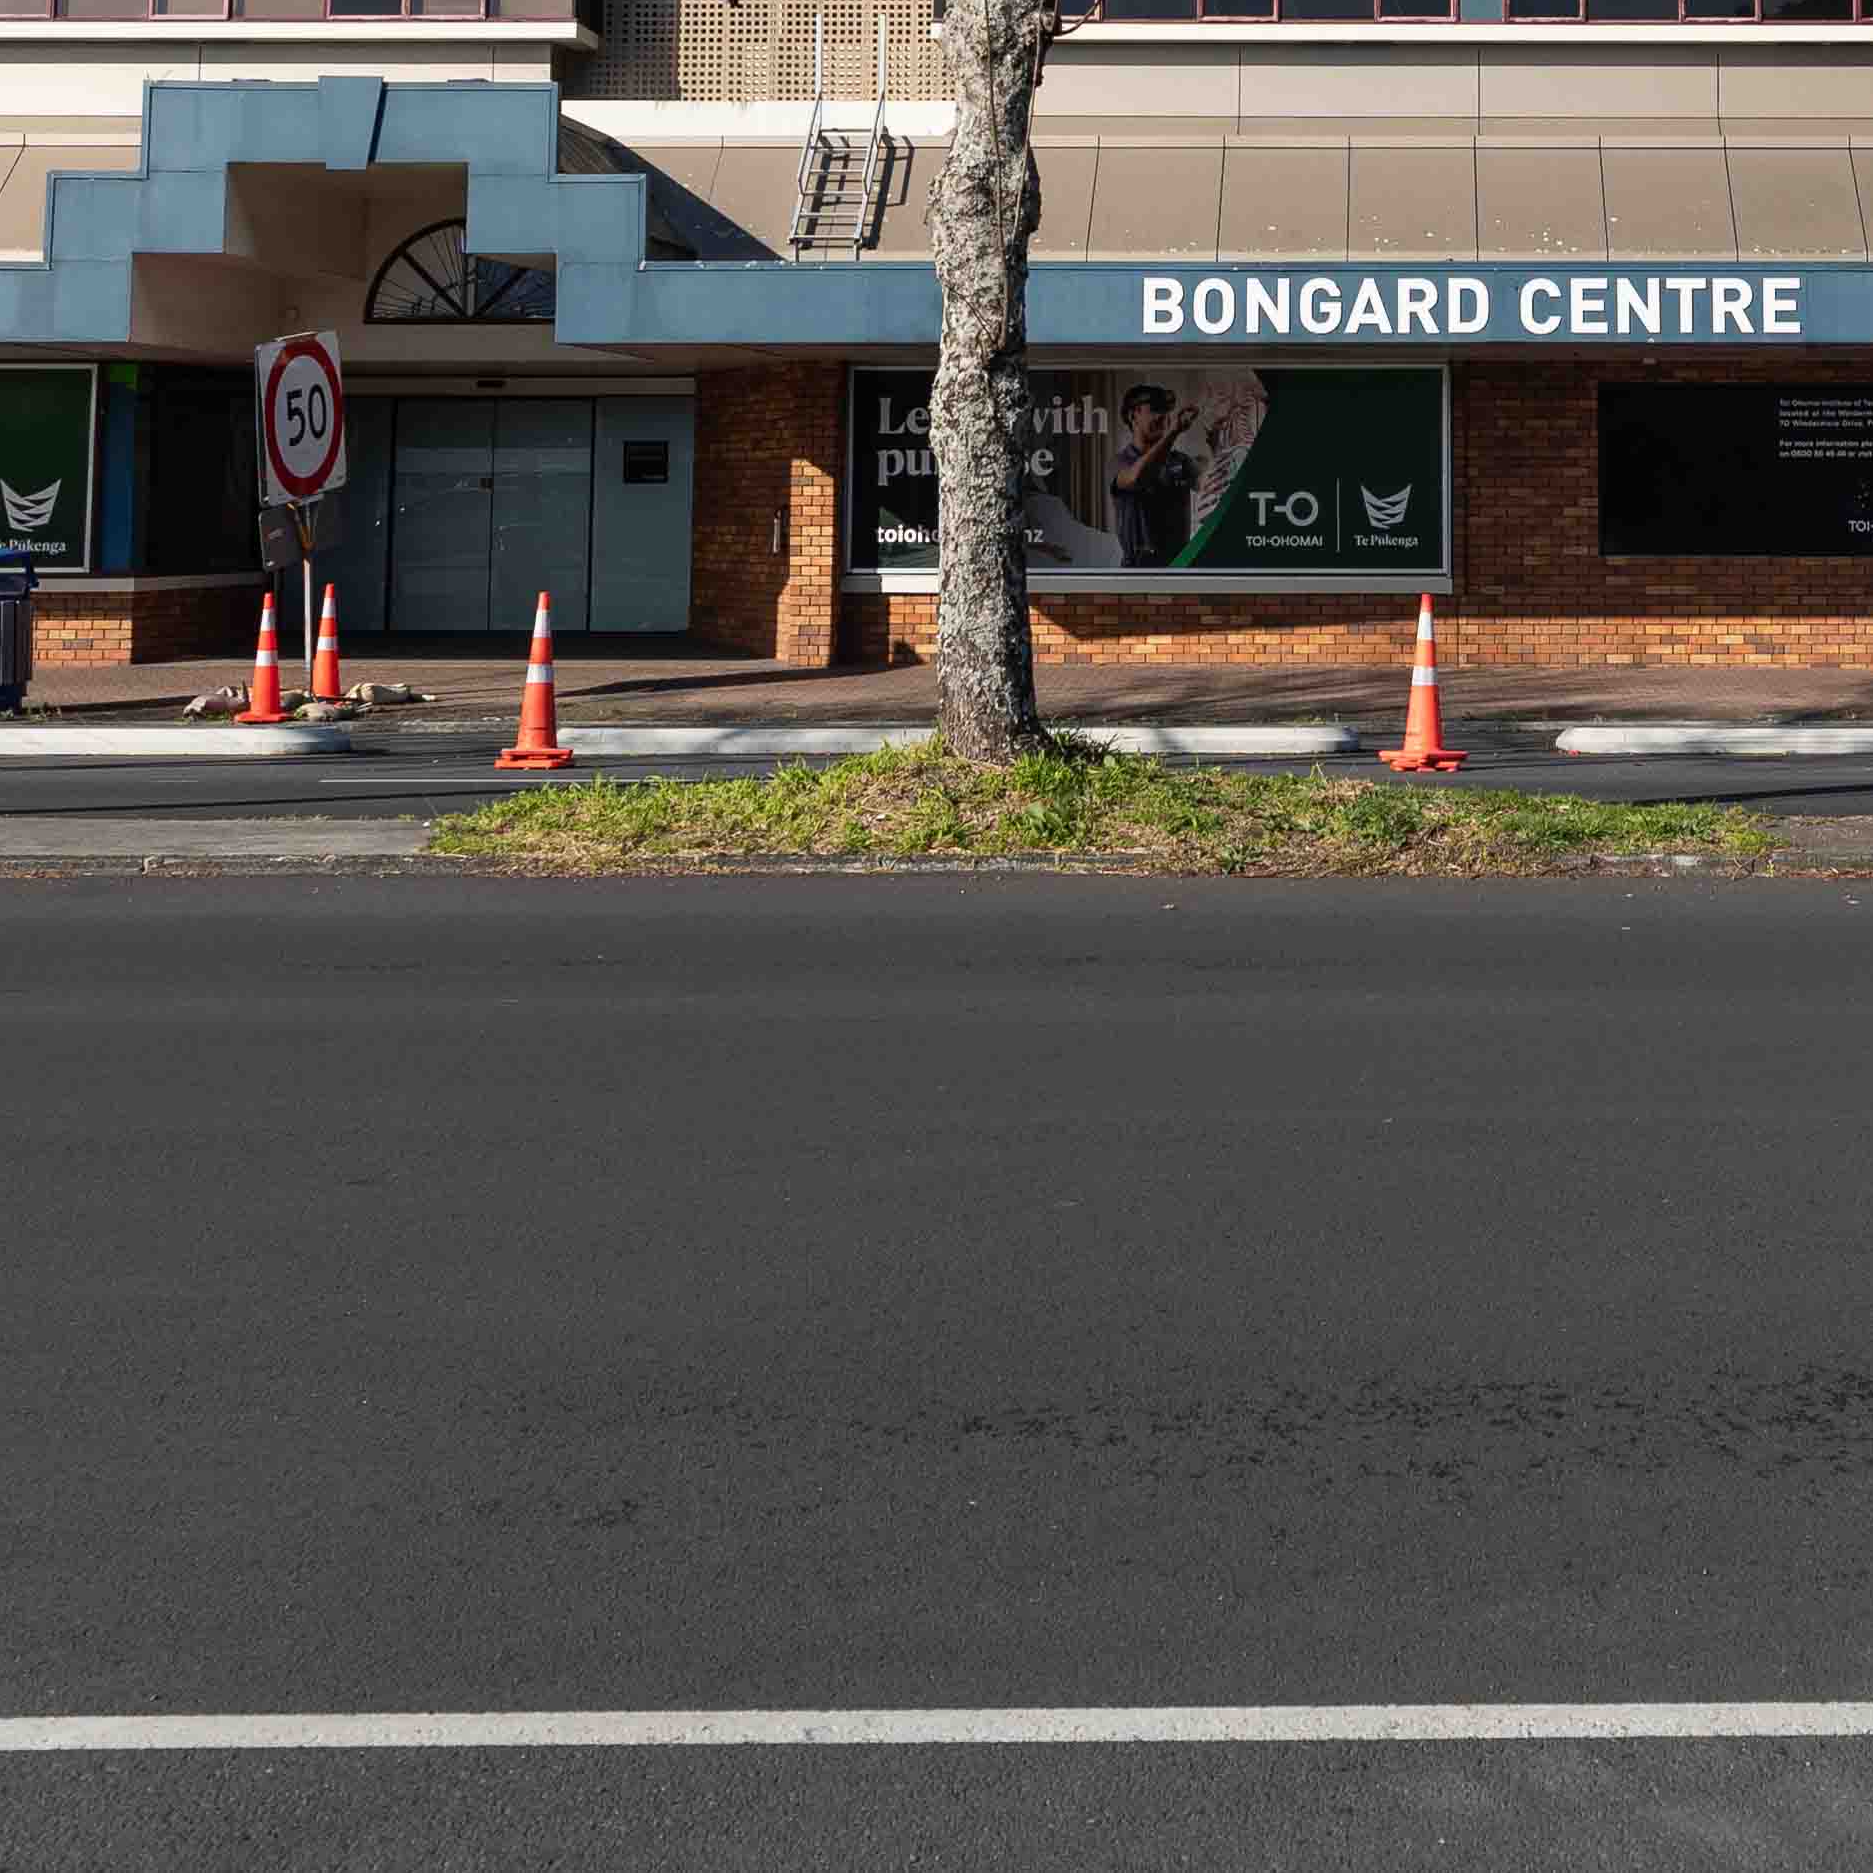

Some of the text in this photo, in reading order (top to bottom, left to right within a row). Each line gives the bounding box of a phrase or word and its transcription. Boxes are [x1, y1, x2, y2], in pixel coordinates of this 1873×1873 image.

[1142, 277, 1803, 335] BONGARD CENTRE
[286, 383, 326, 447] 50
[1354, 534, 1369, 547] Te
